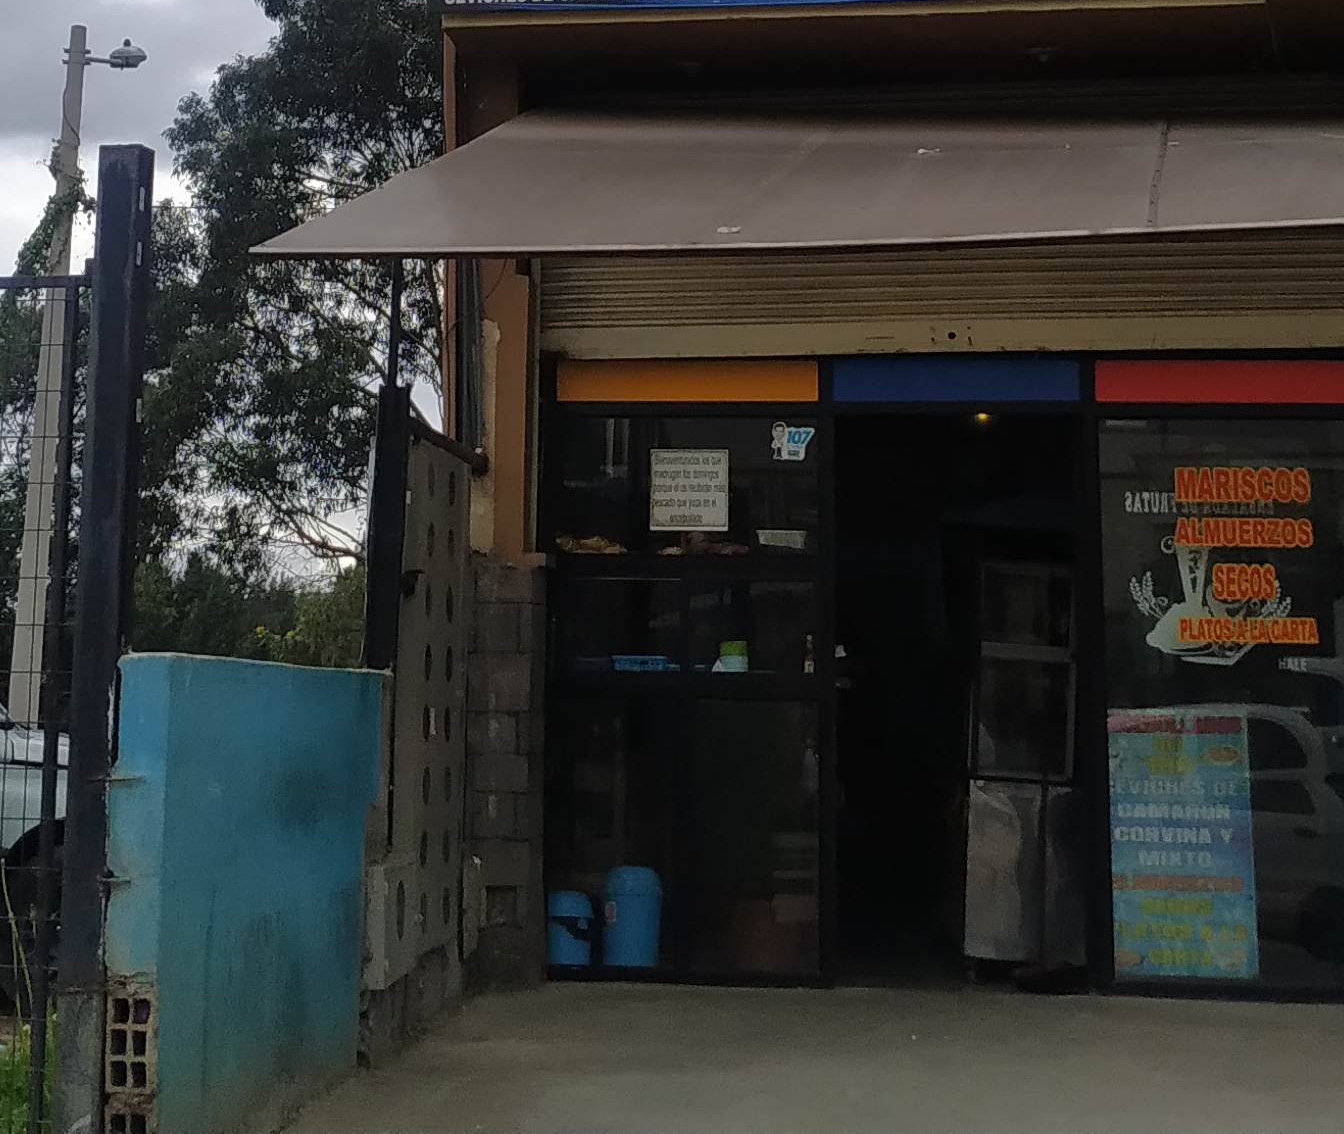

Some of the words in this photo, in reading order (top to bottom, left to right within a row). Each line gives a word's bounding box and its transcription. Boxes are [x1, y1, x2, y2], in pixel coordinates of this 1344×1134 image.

[787, 429, 814, 445] 107
[1174, 466, 1312, 502] MARISCOS
[1174, 517, 1313, 547] ALMUERZOS
[1212, 563, 1276, 600] SECOS
[1179, 617, 1233, 642] PLATOS
[1235, 617, 1247, 642] A
[1249, 617, 1266, 642] LA
[1269, 617, 1320, 644] CARTA
